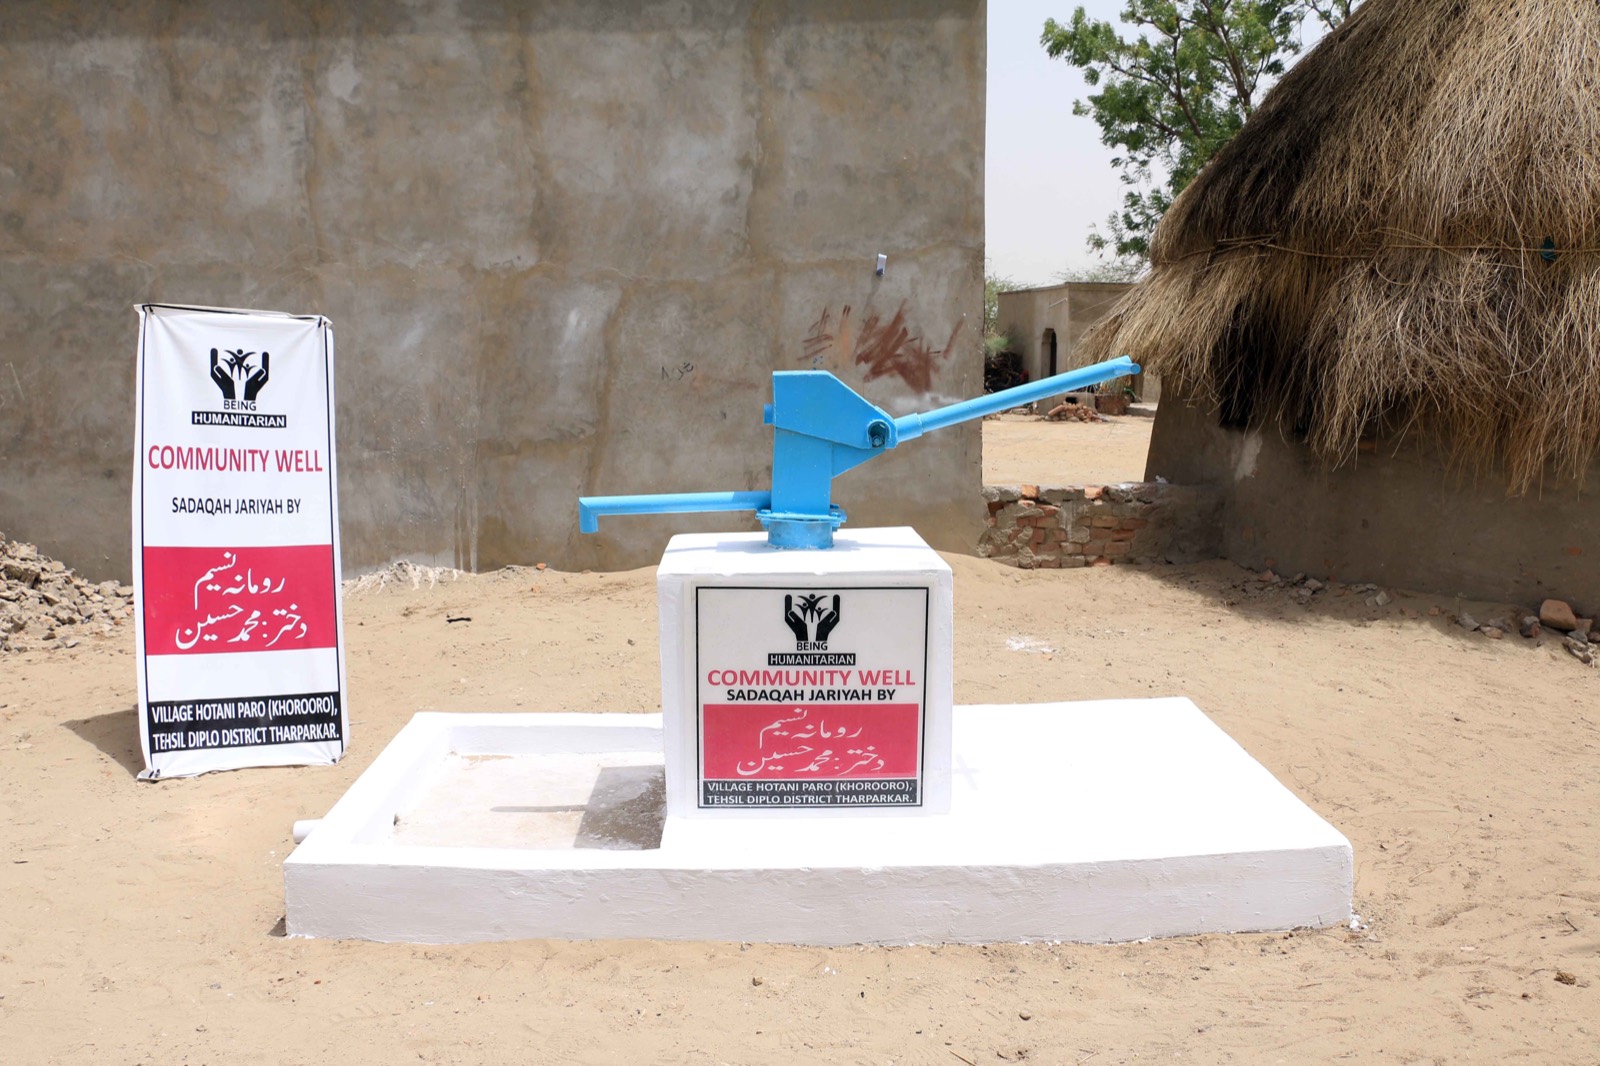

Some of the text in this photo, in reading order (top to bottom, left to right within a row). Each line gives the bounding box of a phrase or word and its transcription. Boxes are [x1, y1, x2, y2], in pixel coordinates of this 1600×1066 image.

[223, 400, 257, 411] BEING
[193, 412, 286, 428] HUMANITARIAN
[148, 444, 323, 472] COMMUNITY WELL
[171, 496, 301, 516] SADAQAH JARIYAH BY
[796, 641, 828, 652] BEING
[769, 654, 855, 666] HUMANITARIAN
[707, 669, 916, 687] COMMUNITY WELL
[726, 688, 896, 703] SADAQAH JARIYAH BY
[151, 695, 338, 724] VILLAGE HOTANI PARO (KHOROORO),
[153, 722, 340, 751] TEHSIL DIPLO DISTRICT THARPARKAR.
[707, 780, 914, 793] VILLAGE HOTANI PARO (KHOROORO),
[706, 793, 914, 805] TEHSIL DIPLO DISTRICT THARPARKAR.
